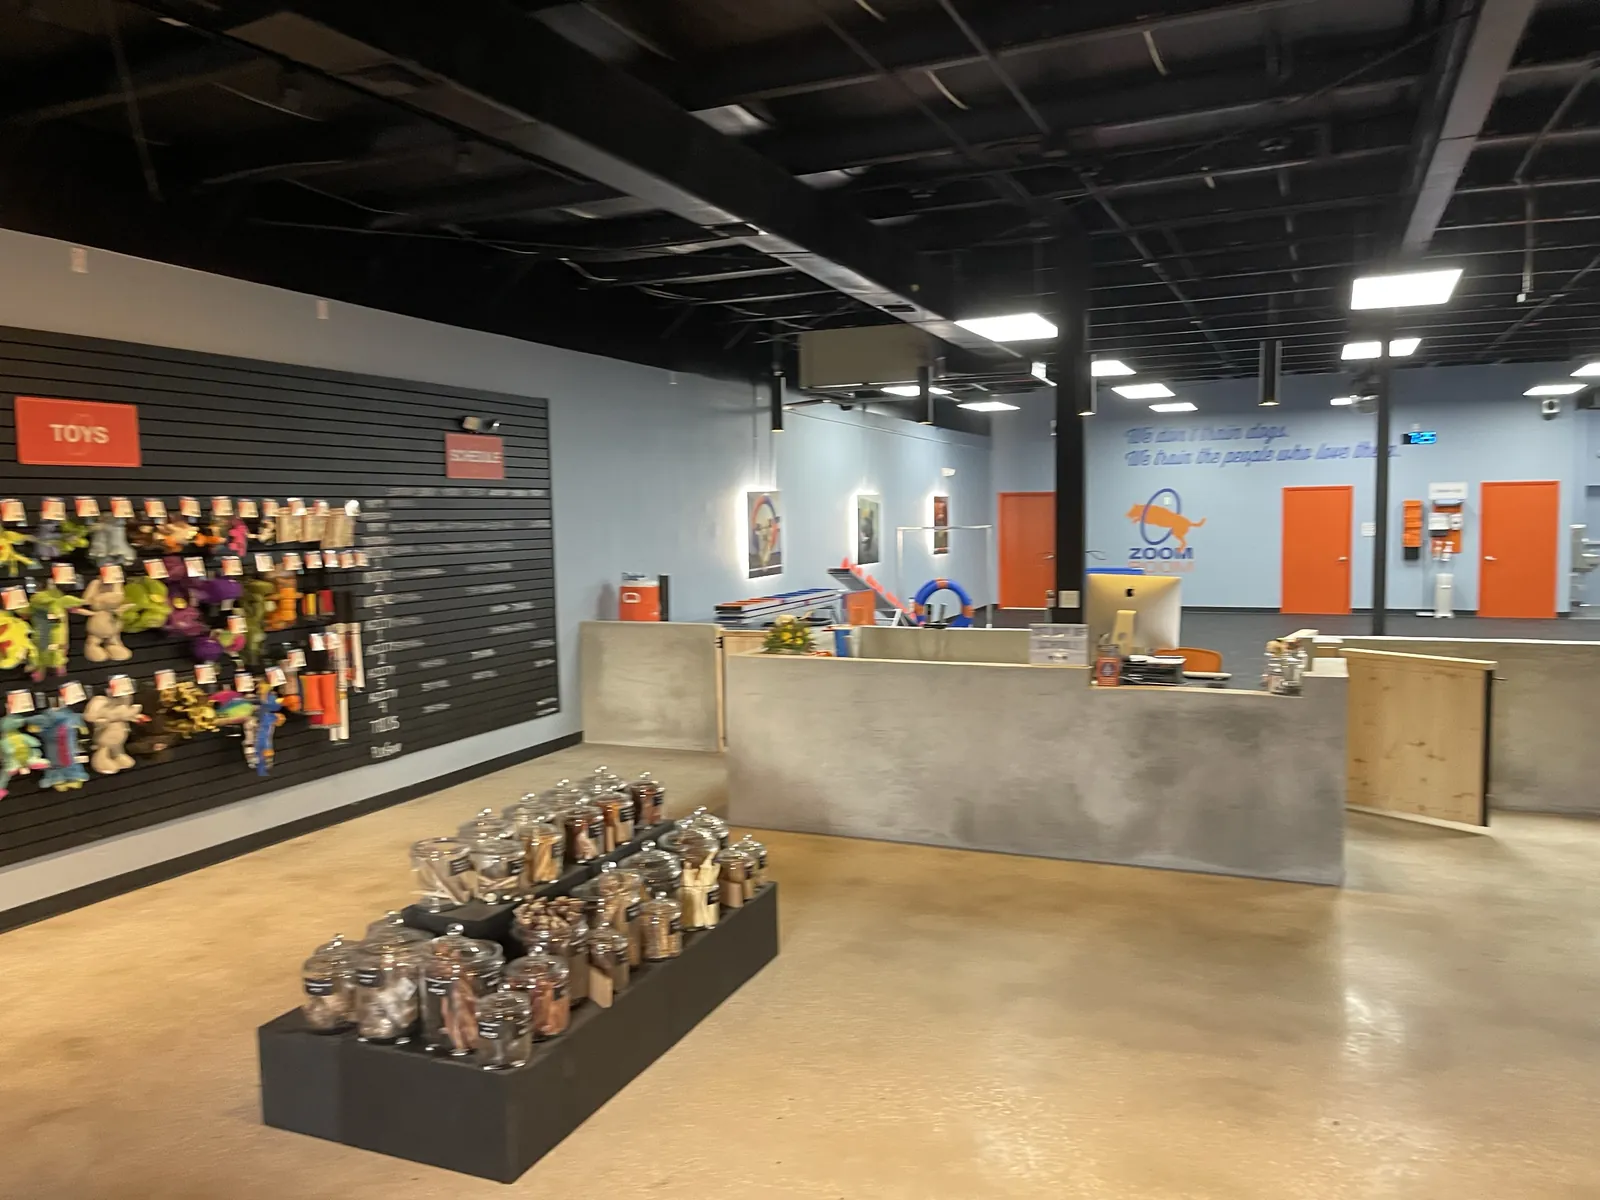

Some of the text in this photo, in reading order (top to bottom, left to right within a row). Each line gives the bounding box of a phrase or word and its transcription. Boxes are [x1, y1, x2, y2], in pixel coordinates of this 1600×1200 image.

[49, 423, 110, 444] TOYS
[1126, 427, 1152, 444] We
[1125, 450, 1151, 466] We
[1153, 449, 1192, 465] train
[1195, 447, 1220, 464] the
[1219, 445, 1274, 468] people
[1276, 444, 1312, 461] who
[1315, 443, 1350, 460] love
[1128, 547, 1195, 560] ZOOM
